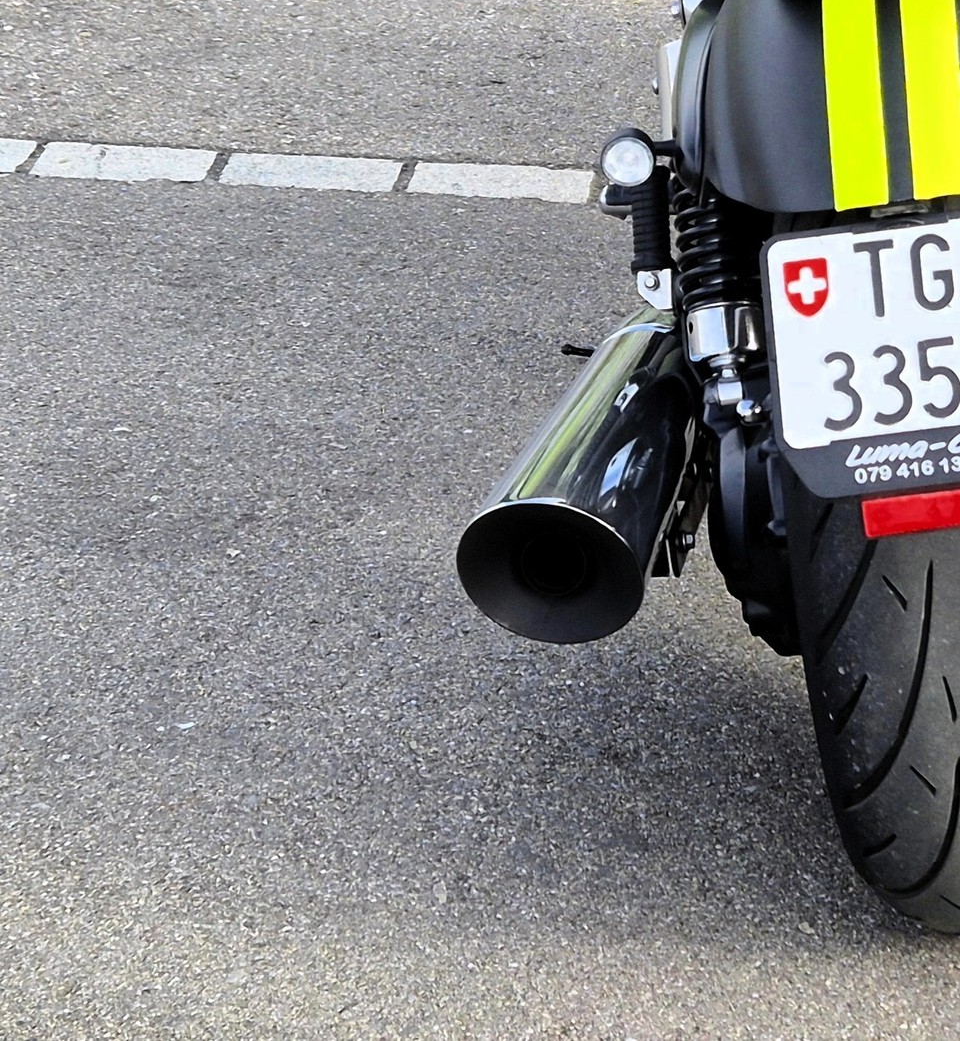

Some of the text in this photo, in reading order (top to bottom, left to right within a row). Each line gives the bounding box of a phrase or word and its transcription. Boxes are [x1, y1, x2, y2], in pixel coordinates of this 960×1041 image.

[853, 233, 955, 318] TG
[854, 464, 892, 484] 079
[896, 459, 934, 479] 416
